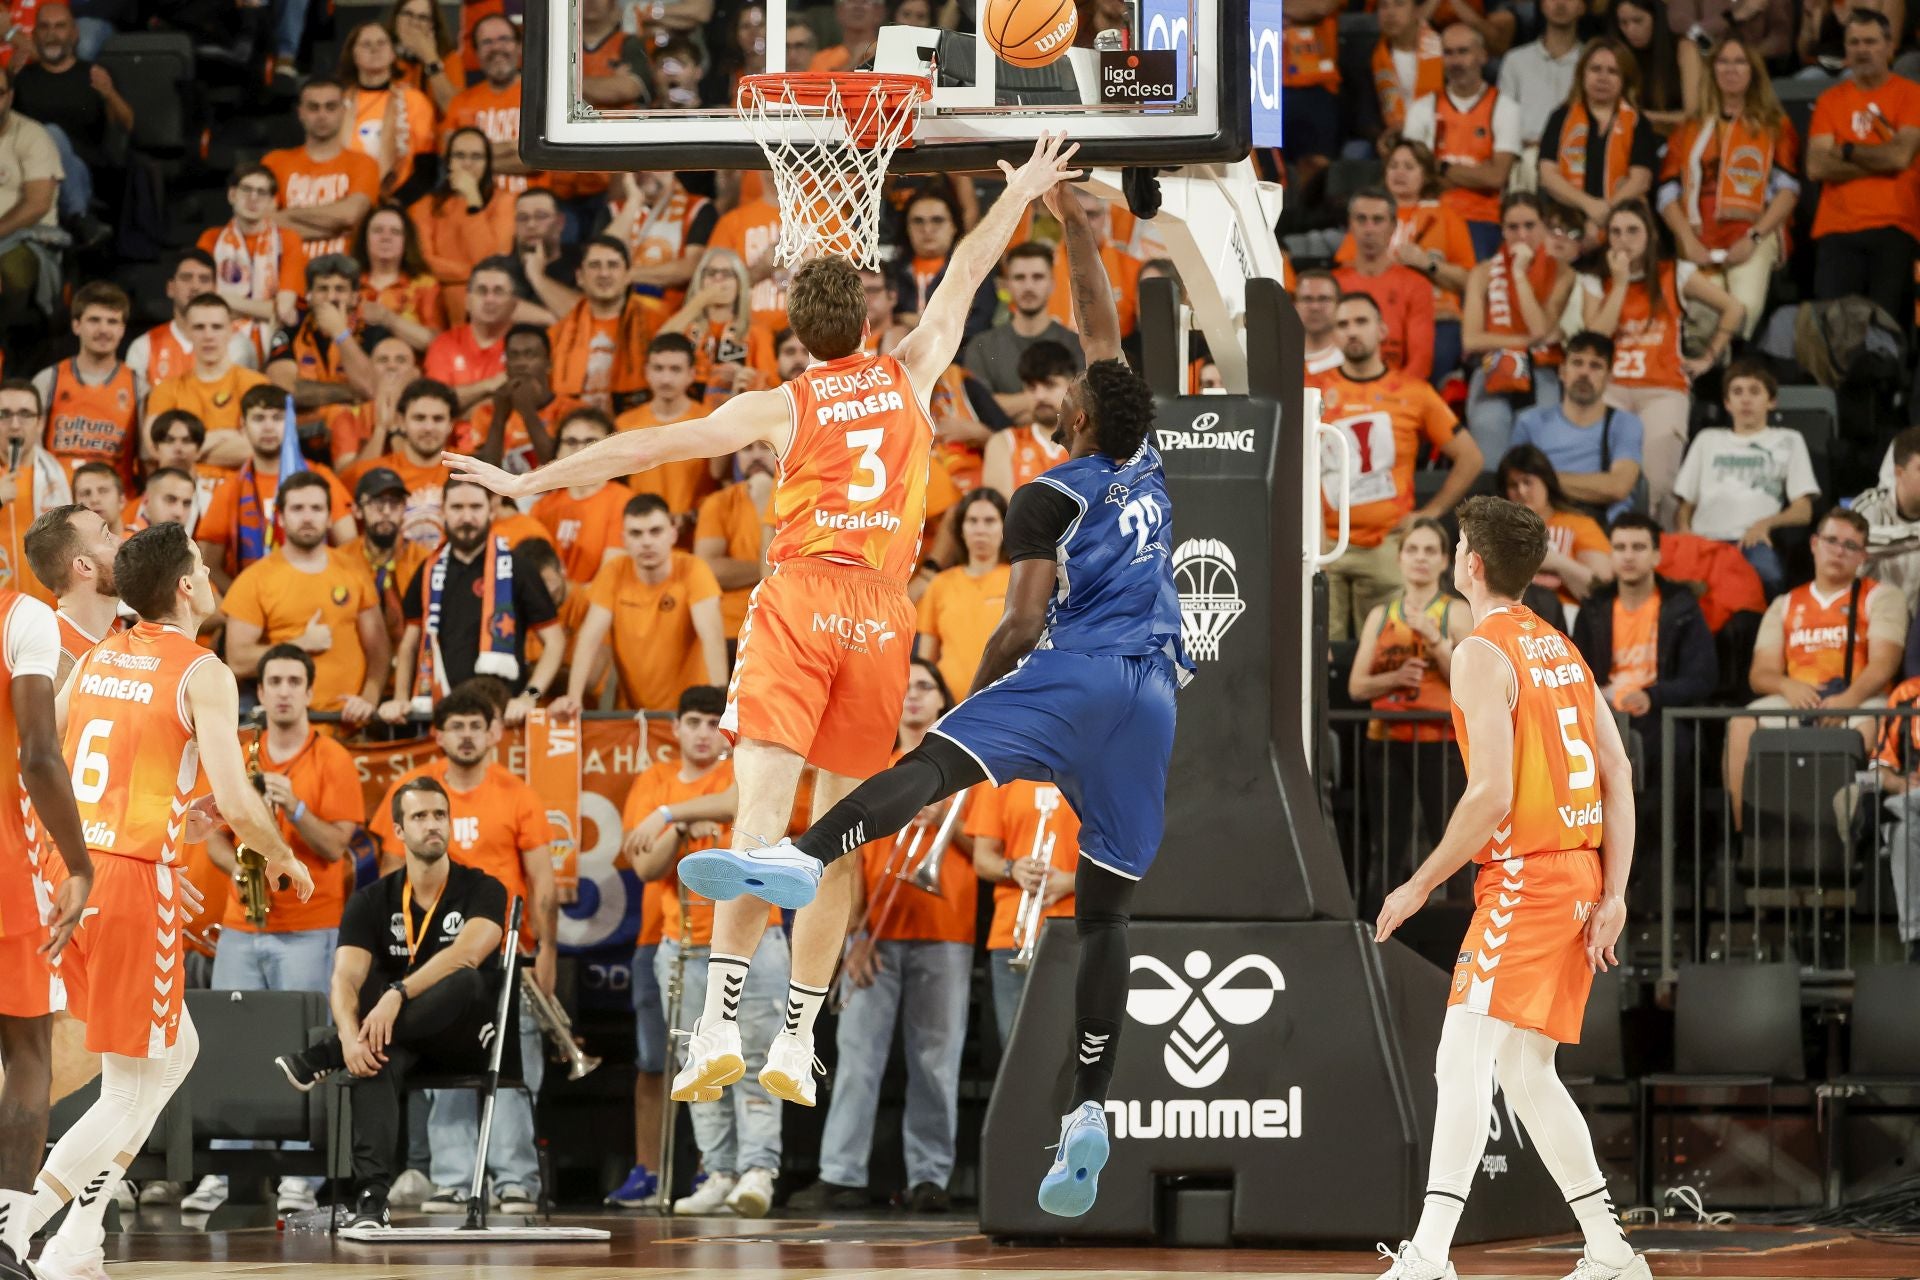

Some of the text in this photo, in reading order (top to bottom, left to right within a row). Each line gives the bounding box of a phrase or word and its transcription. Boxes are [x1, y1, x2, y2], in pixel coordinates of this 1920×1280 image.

[1034, 8, 1078, 53] Wilson
[1104, 66, 1137, 83] liga
[1104, 83, 1174, 98] endesa
[1613, 351, 1646, 377] 23
[845, 427, 887, 502] 3
[812, 612, 867, 643] MGS
[79, 673, 154, 704] PAMESA
[71, 718, 115, 804] 6
[1557, 705, 1595, 790] 5
[389, 944, 416, 956] Sta
